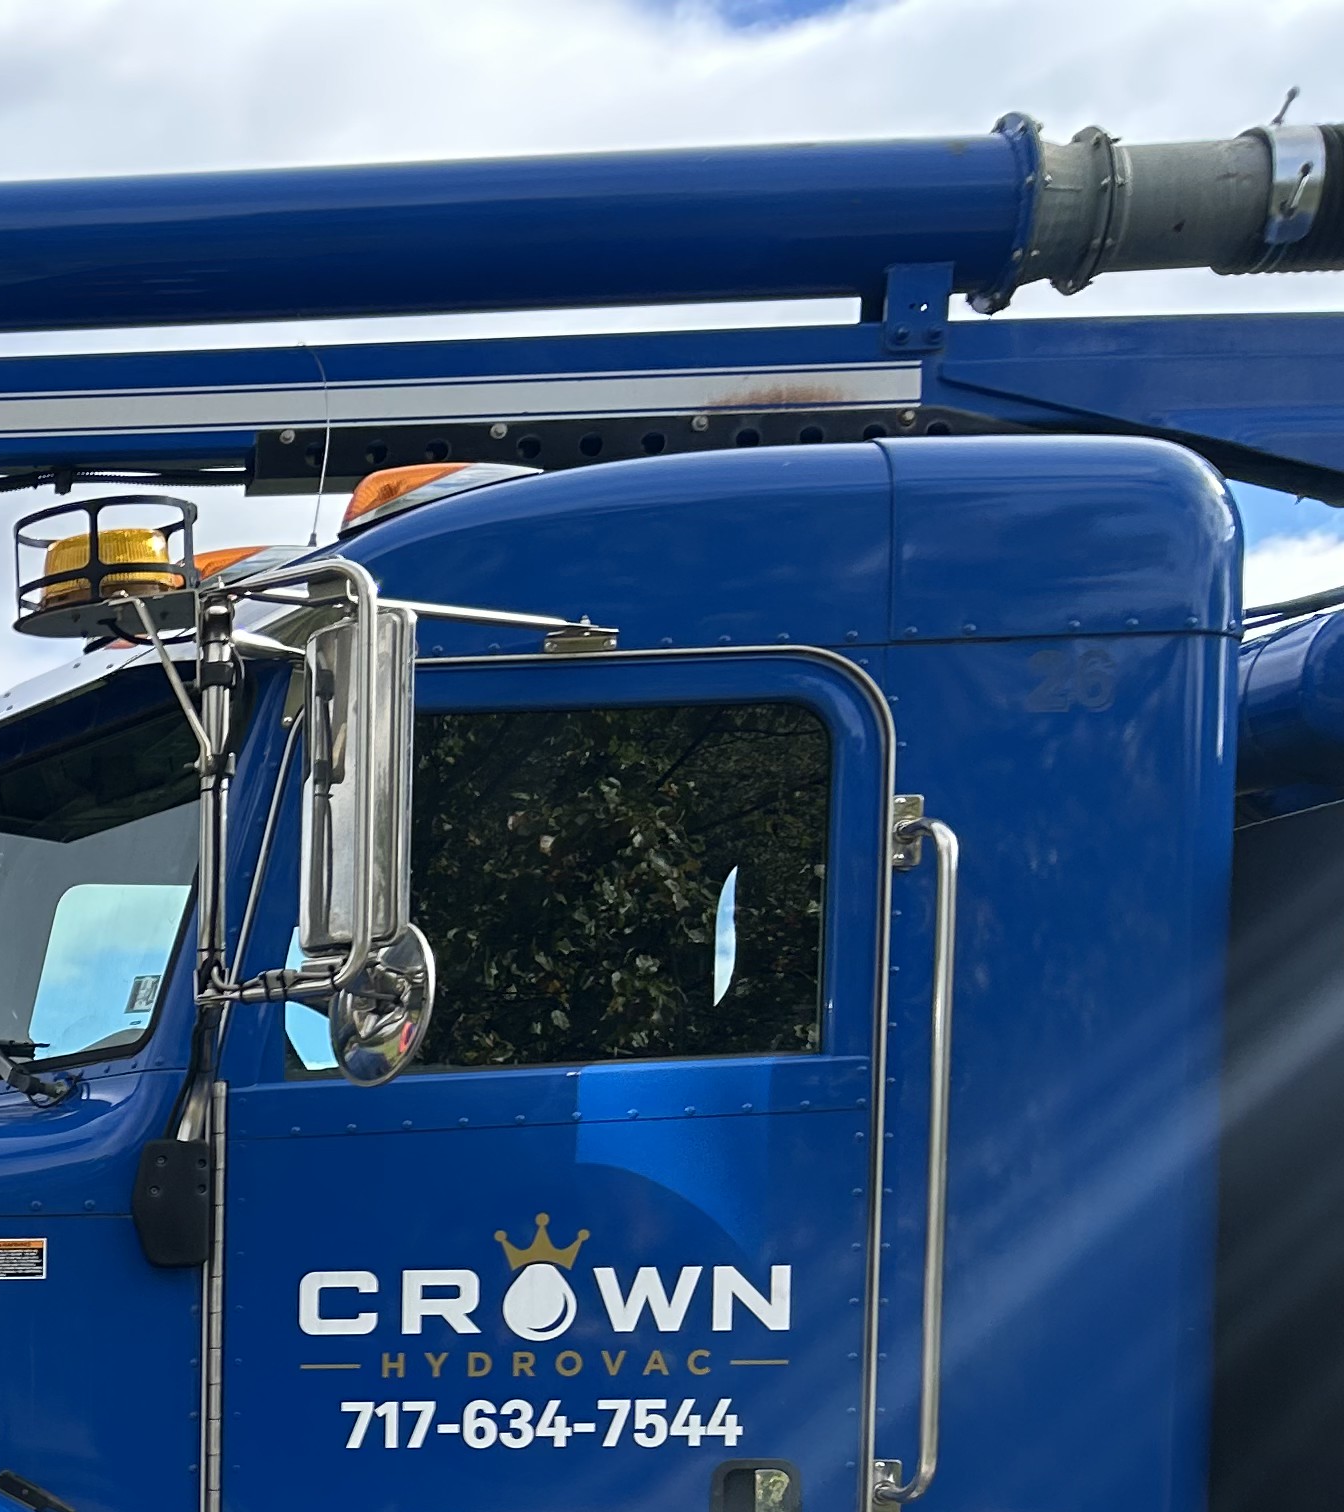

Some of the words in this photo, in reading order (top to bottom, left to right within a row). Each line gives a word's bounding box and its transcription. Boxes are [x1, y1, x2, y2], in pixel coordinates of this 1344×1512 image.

[298, 1263, 792, 1341] CROWN
[381, 1349, 713, 1379] HYDROVAC
[339, 1397, 745, 1450] 717-634-7544
